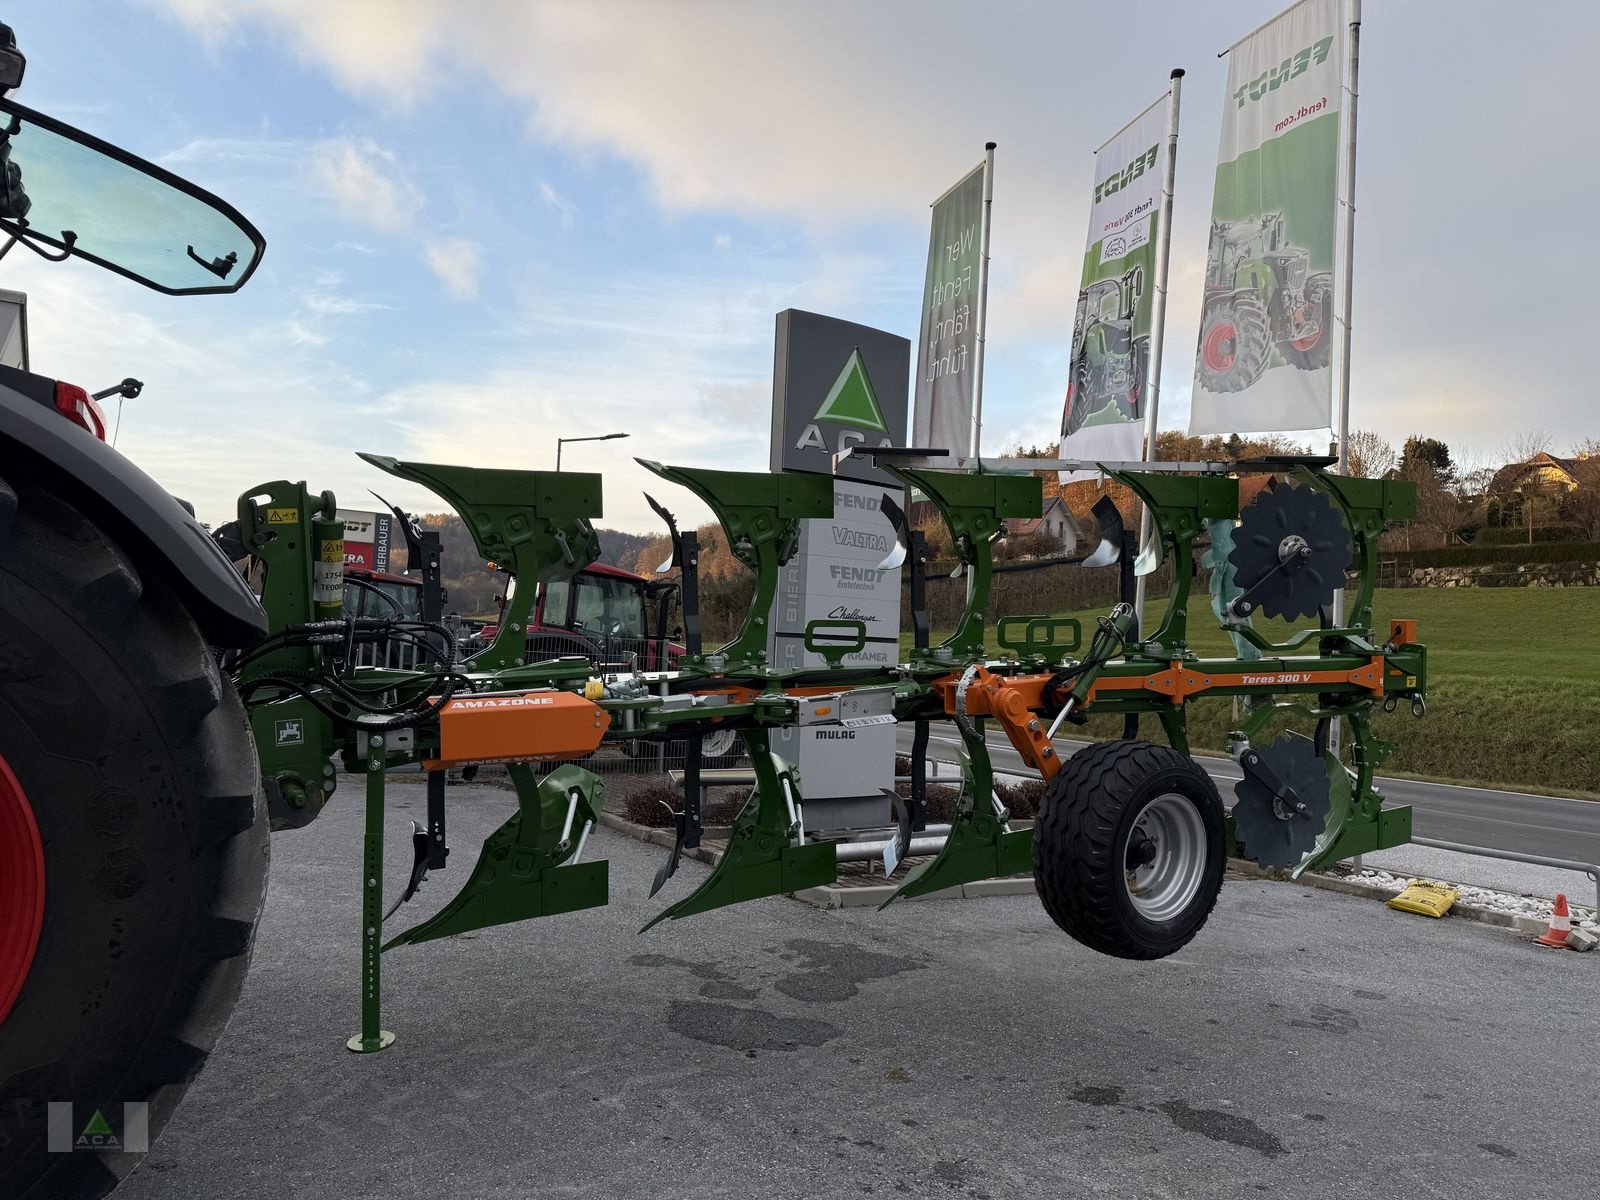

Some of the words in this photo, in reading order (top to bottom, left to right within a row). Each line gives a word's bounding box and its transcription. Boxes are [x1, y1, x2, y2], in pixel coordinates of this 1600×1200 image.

[834, 492, 881, 512] FEND
[377, 518, 389, 574] BIERBAUER
[832, 526, 888, 552] VALTRA
[829, 565, 886, 583] FENDT
[827, 605, 882, 623] Challenger
[848, 652, 888, 663] KRAMER
[1242, 675, 1275, 684] Teres
[1277, 674, 1301, 683] 300
[1302, 673, 1312, 683] V
[451, 697, 554, 709] AMAZONE
[815, 730, 856, 740] MULAG
